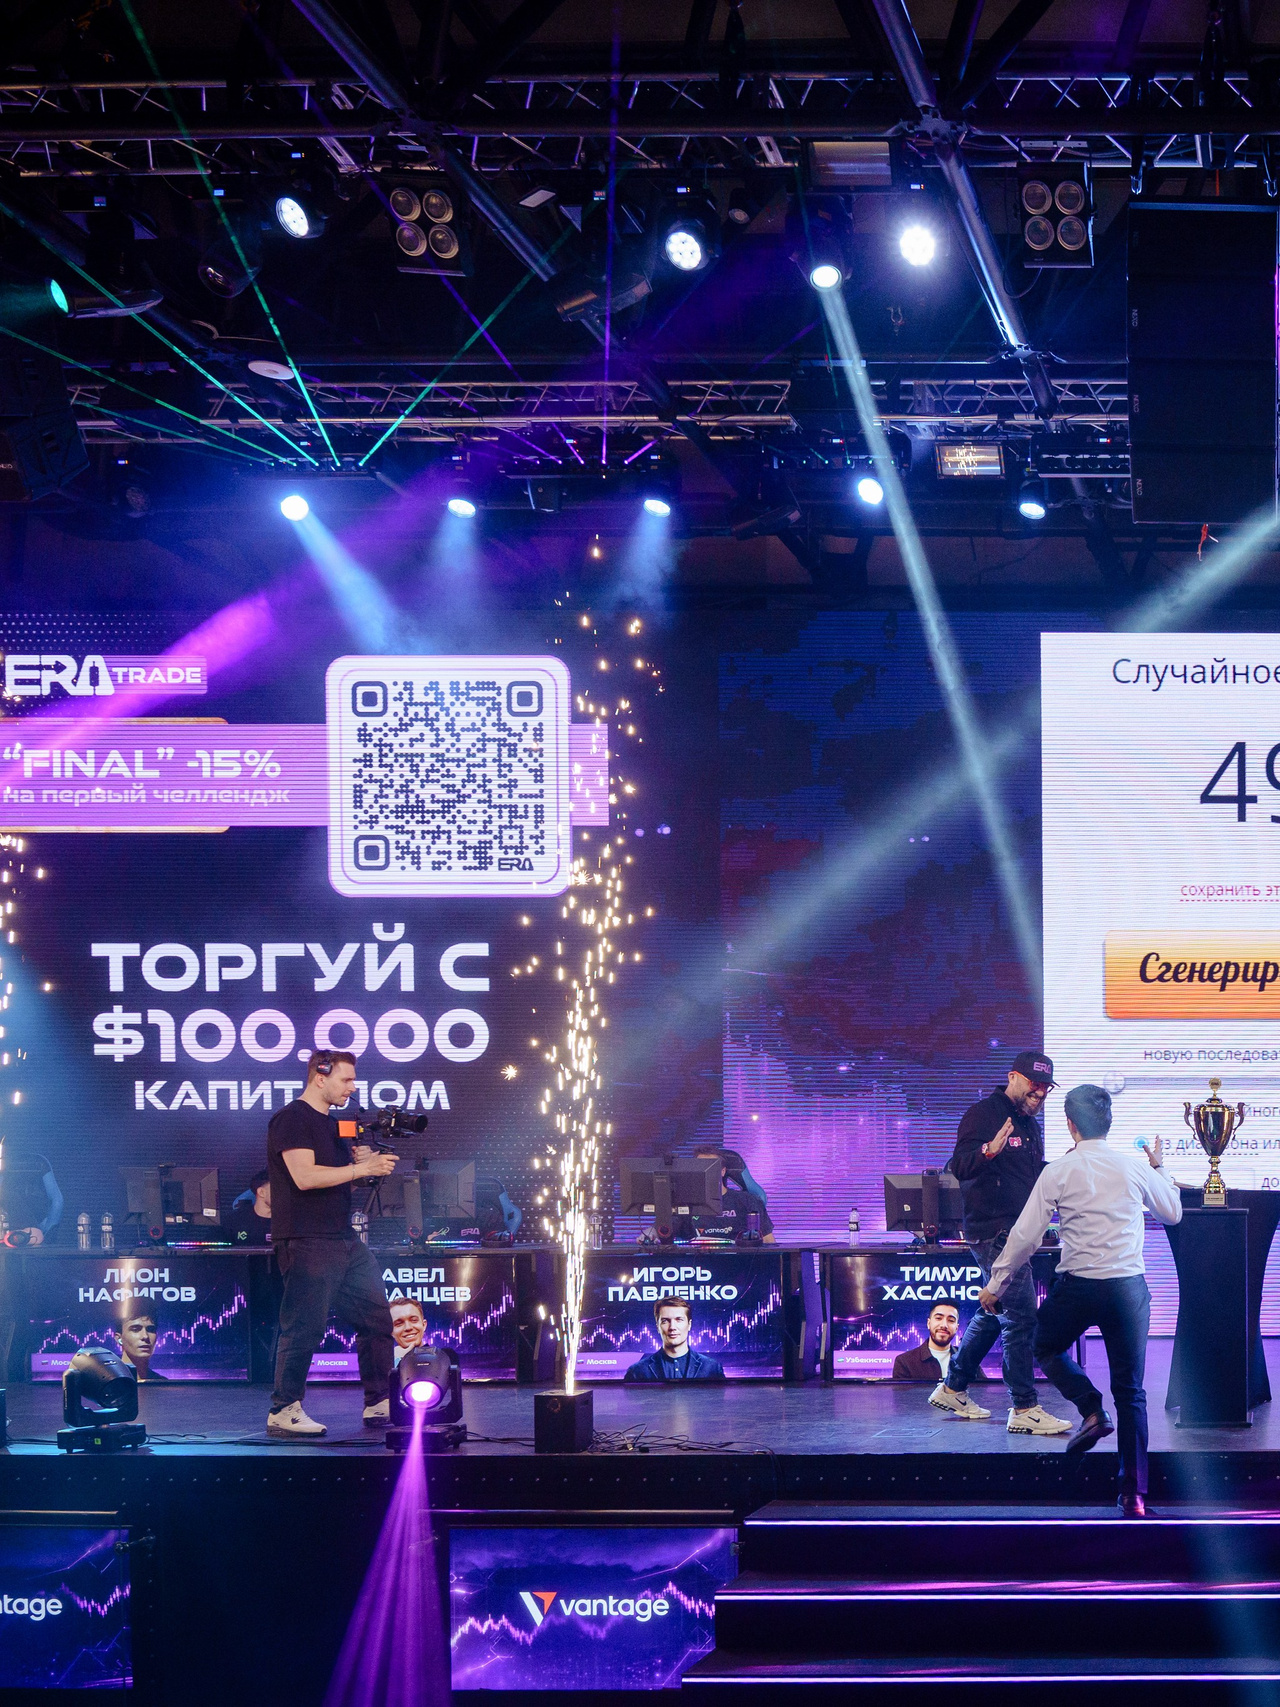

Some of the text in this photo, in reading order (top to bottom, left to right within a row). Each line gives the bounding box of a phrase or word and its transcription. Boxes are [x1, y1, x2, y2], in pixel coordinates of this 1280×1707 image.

[4, 654, 201, 696] ERA TRADE
[2, 783, 291, 806] на первый челлендж
[498, 857, 534, 871] ERA
[1180, 884, 1261, 898] сохранить
[91, 922, 490, 993] ТОРГУЙ С
[91, 1004, 490, 1063] $100.000
[1143, 1050, 1194, 1063] новую
[134, 1080, 451, 1110] КАПИТЛОМ
[1261, 1177, 1280, 1191] до
[103, 1267, 170, 1283] ЛИОН
[381, 1267, 446, 1283] АВЕЛ
[632, 1267, 712, 1283] ИГОРЬ
[899, 1266, 982, 1282] ТИМУР
[78, 1286, 197, 1302] НАФИГОВ
[385, 1286, 472, 1306] АНЦЕВ
[607, 1285, 738, 1302] ПАВЛЕНКО
[881, 1285, 983, 1301] ХАСАНО
[317, 1358, 348, 1367] Москва
[586, 1358, 617, 1366] Москва
[845, 1356, 892, 1364] Узбекистан
[0, 1593, 62, 1621] tage
[560, 1593, 670, 1622] vantage
